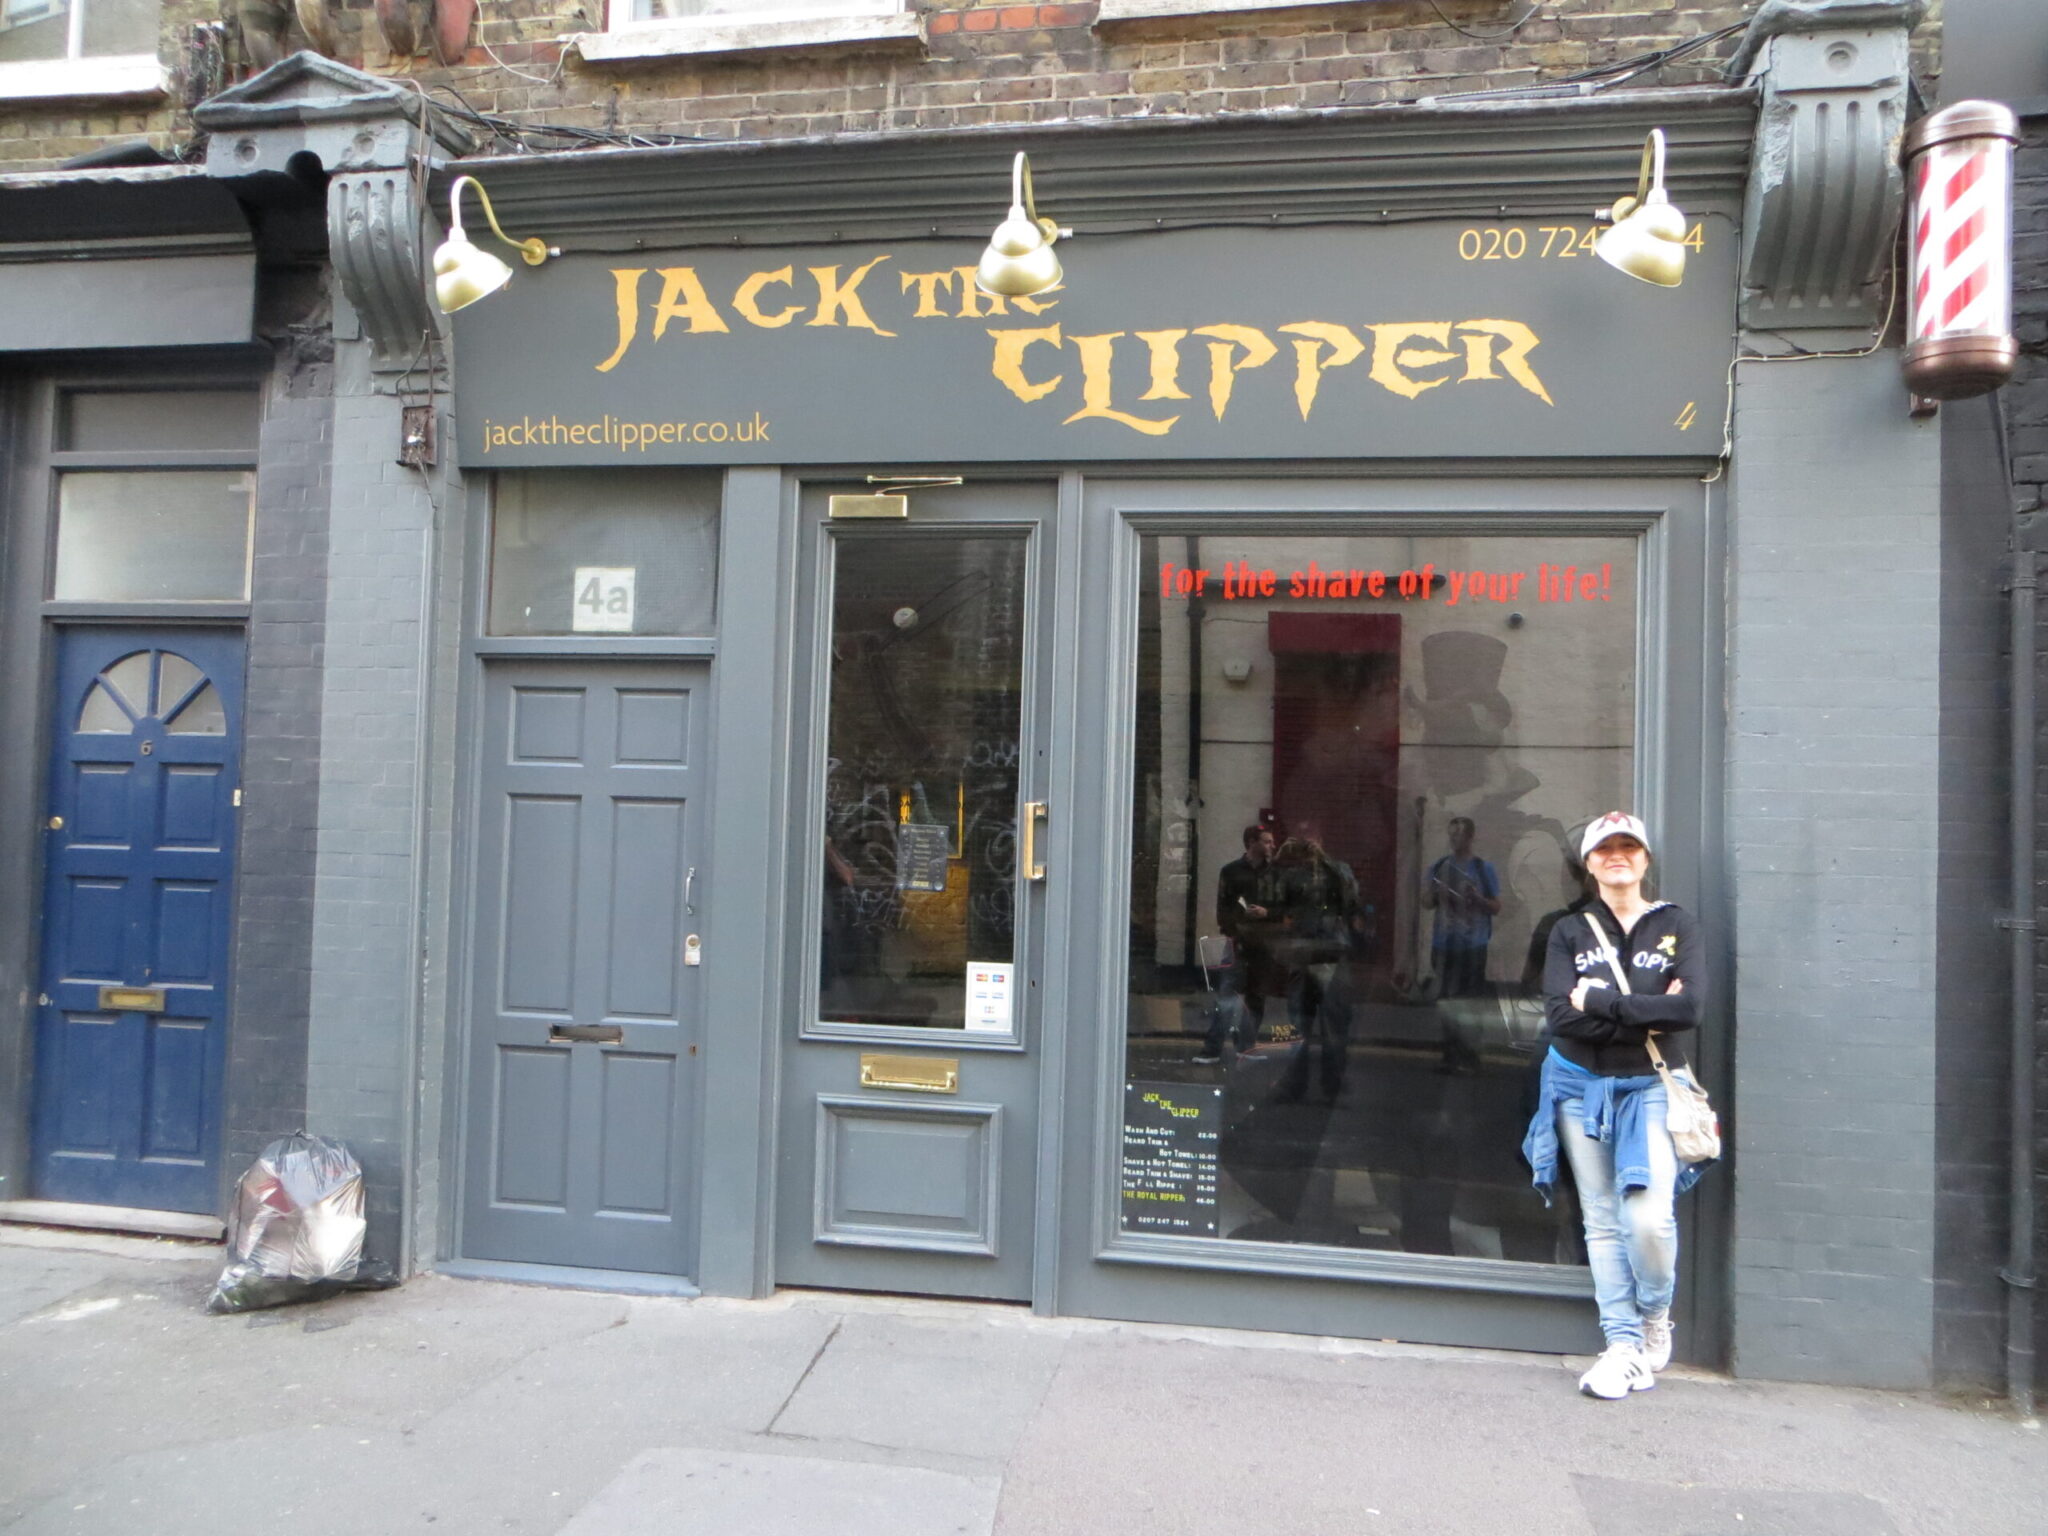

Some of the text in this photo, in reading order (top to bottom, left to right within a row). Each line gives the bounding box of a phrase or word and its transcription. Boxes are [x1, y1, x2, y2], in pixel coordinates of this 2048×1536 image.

[1459, 227, 1526, 261] 020
[596, 255, 897, 372] JACK
[986, 319, 1554, 435] CLIPPER
[484, 411, 770, 453] jacktheclipper.co.uk
[1674, 402, 1696, 430] 4
[578, 577, 628, 614] 4a
[1161, 560, 1613, 606] for the shave of your life!
[140, 740, 153, 756] 6
